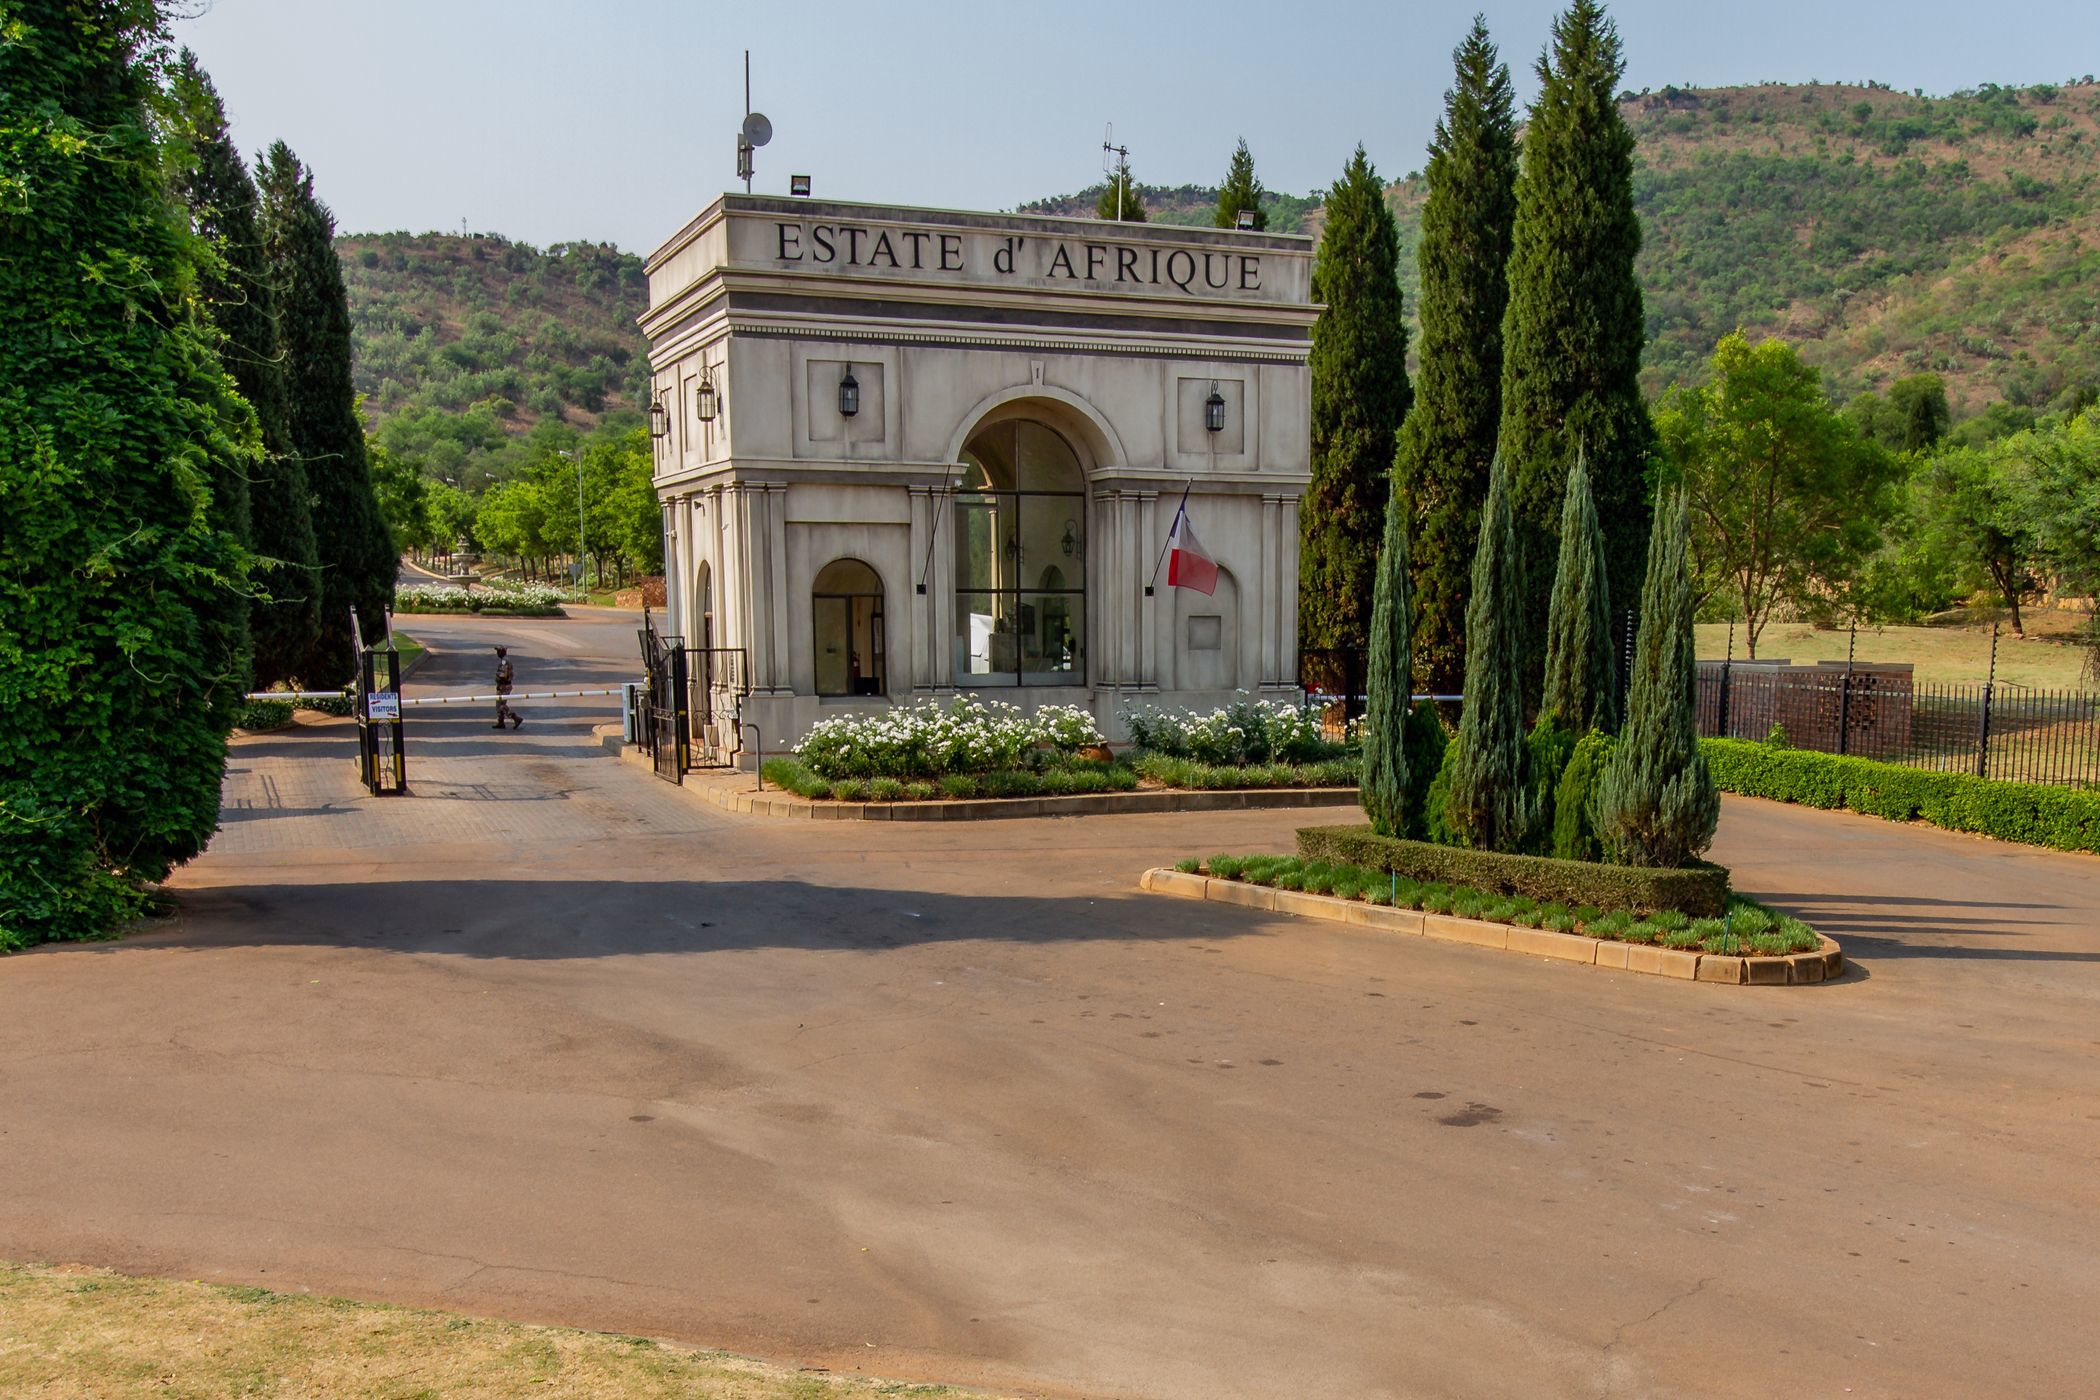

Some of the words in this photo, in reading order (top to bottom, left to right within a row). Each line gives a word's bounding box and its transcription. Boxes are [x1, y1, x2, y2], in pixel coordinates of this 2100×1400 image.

[775, 223, 965, 271] ESTATE
[993, 237, 1024, 274] d'
[1046, 243, 1263, 295] AFRIQUE
